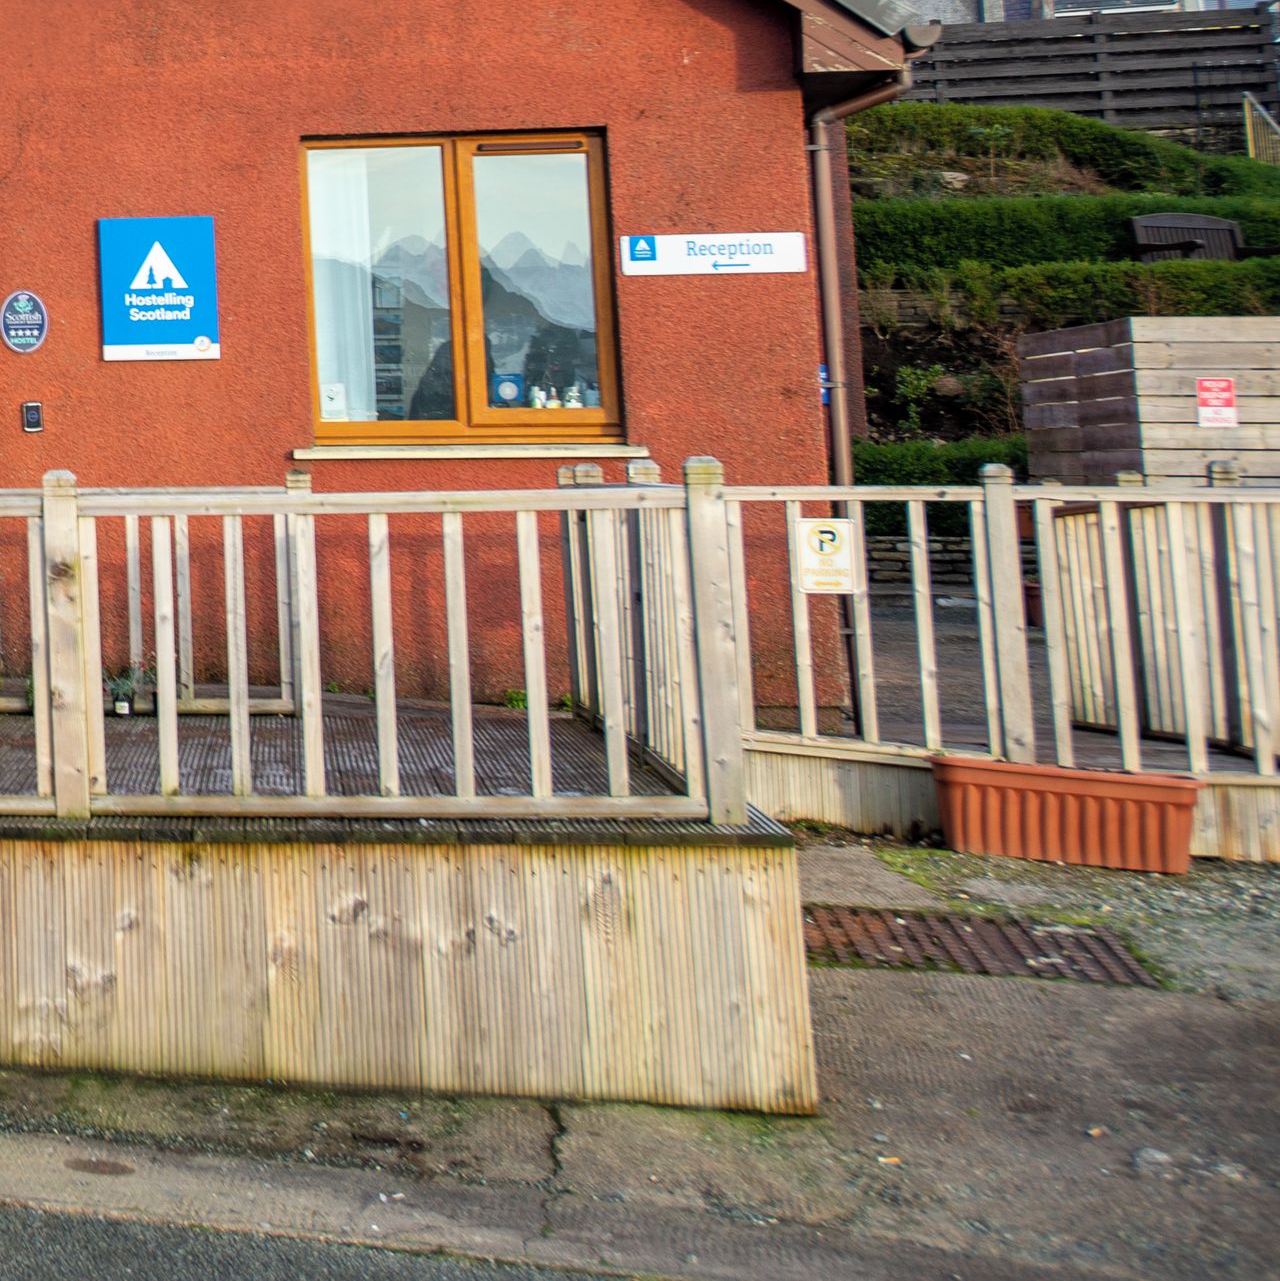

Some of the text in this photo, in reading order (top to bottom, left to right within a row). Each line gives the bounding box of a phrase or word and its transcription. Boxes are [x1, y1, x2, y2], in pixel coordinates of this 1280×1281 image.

[686, 239, 774, 259] Reception
[124, 292, 195, 308] Hostelling
[5, 311, 42, 321] Scottish
[129, 307, 191, 322] Scotland
